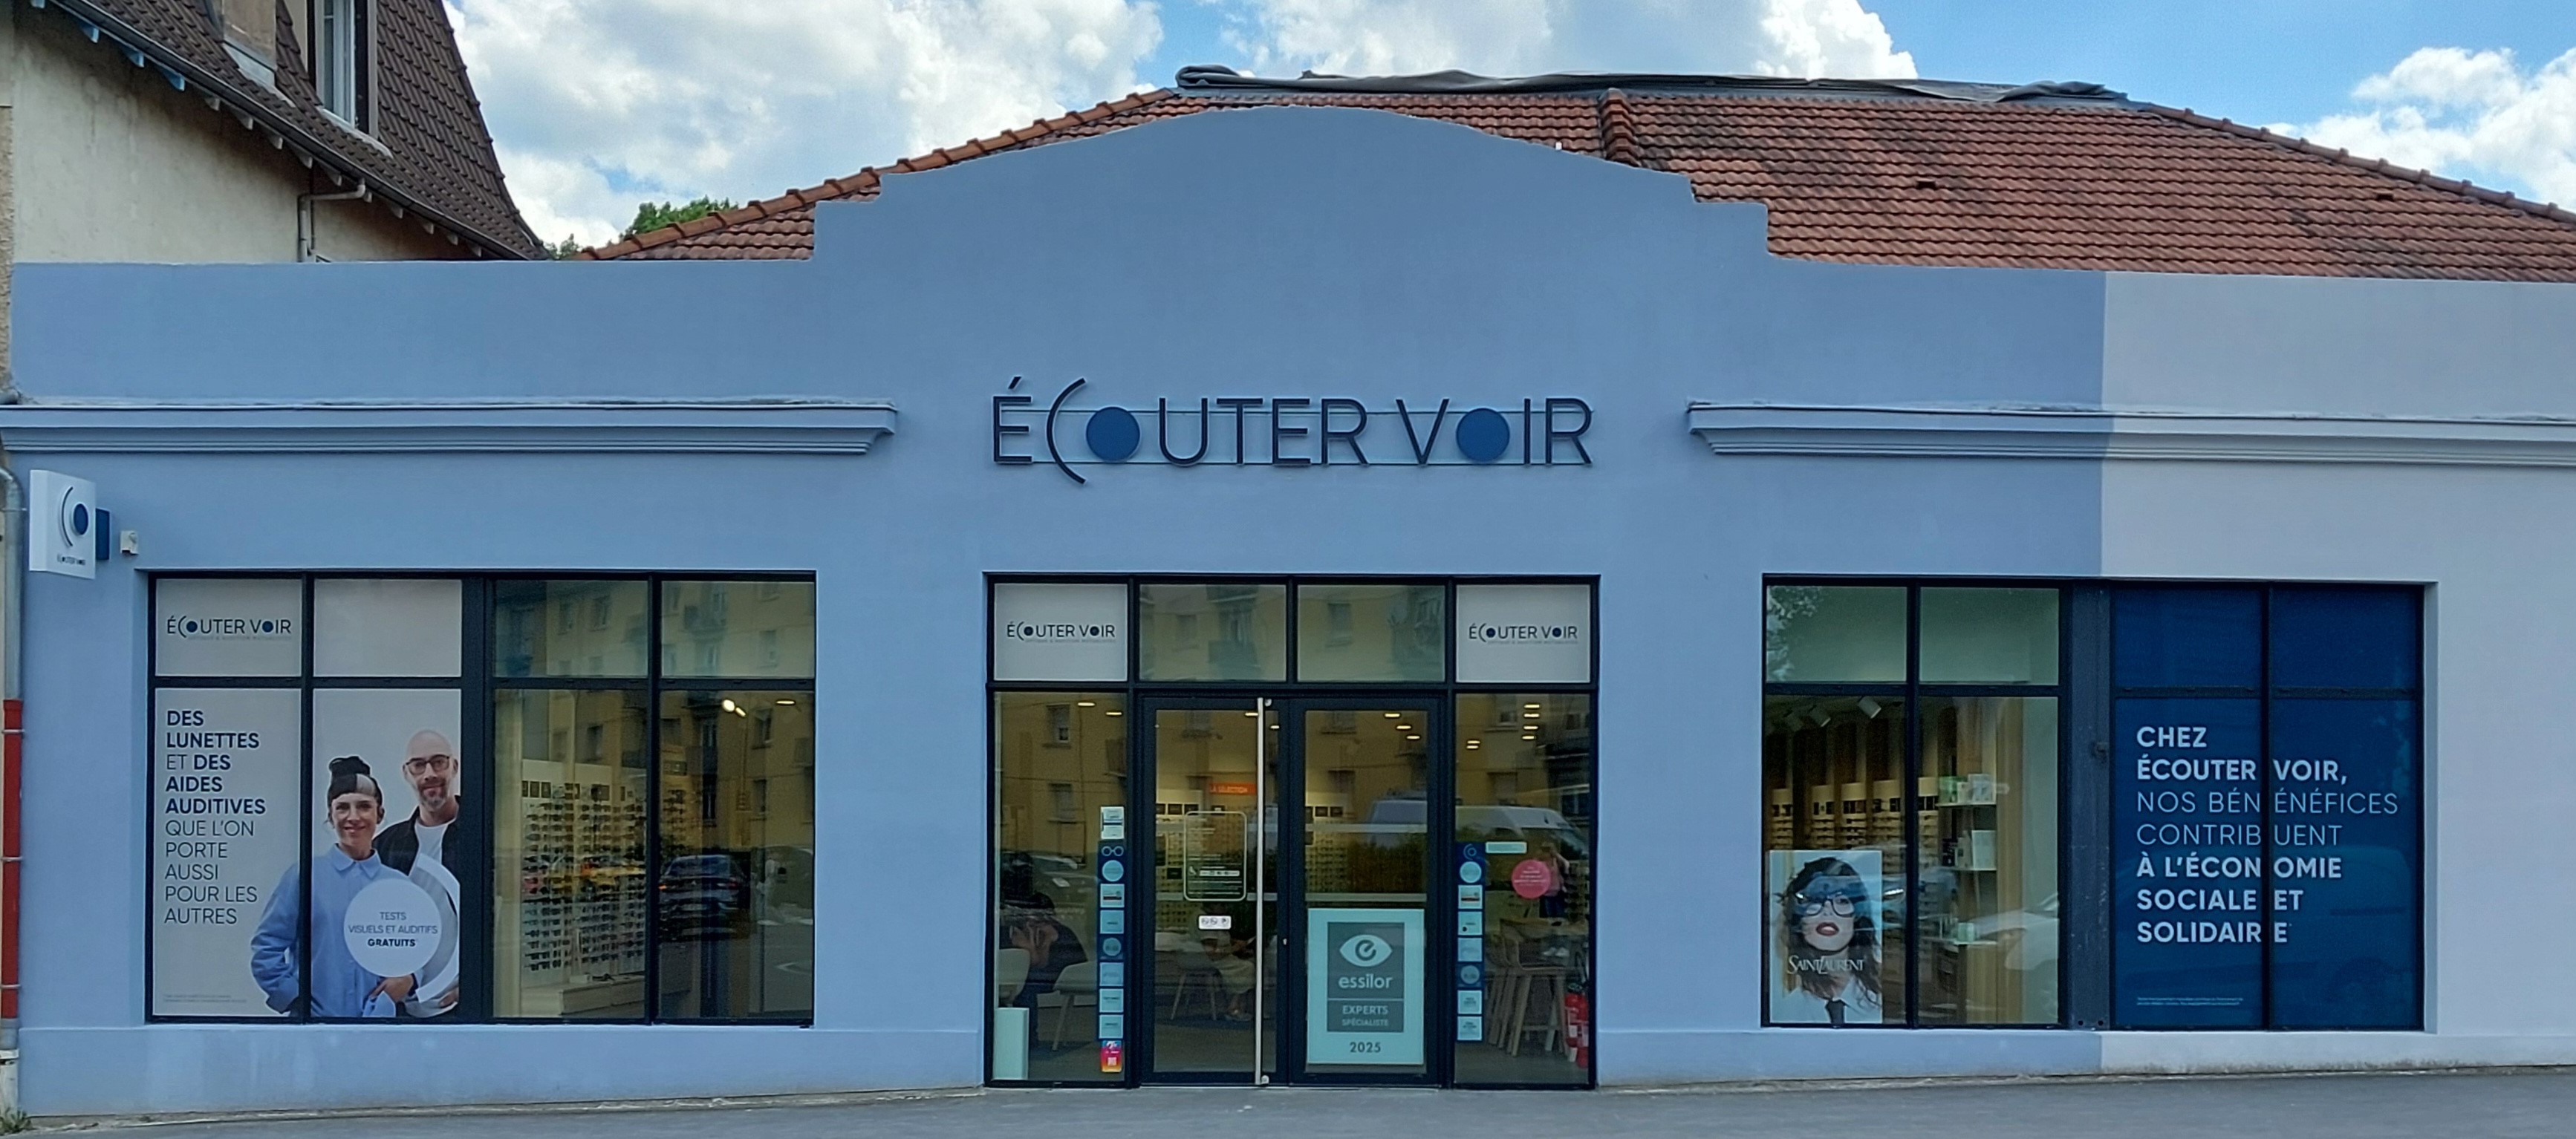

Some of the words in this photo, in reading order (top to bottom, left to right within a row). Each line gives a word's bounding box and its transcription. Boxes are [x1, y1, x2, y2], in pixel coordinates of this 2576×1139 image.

[1396, 397, 1593, 466] VOIR
[250, 619, 291, 634] VOIR
[1079, 624, 1115, 637] VOIR
[1541, 626, 1578, 639] VOIR
[167, 711, 204, 726] DES
[167, 732, 260, 748] LUNETTES
[2136, 726, 2207, 748] CHEZ
[167, 754, 188, 770] ET
[194, 754, 231, 770] DES
[2137, 754, 2257, 780] ÉCOUTER
[2272, 759, 2347, 786] VOIR,
[166, 776, 223, 792] AIDES
[165, 798, 266, 815] AUDITIVES
[2138, 792, 2196, 813] NOS
[166, 820, 206, 836] QUE
[212, 820, 254, 837] L'ON
[166, 842, 228, 858] PORTE
[165, 864, 218, 880] AUSSI
[2136, 851, 2155, 878] À
[166, 886, 219, 902] POUR
[225, 886, 258, 902] LES
[2136, 889, 2257, 910] SOCIALE
[2274, 890, 2303, 910] ET
[164, 908, 237, 924] AUTRES
[380, 912, 406, 921] TESTS
[348, 925, 384, 934] VISUELS
[386, 925, 396, 934] ET
[398, 925, 438, 934] AUDITIFS
[368, 939, 416, 947] GRATUITS
[1338, 973, 1393, 989] essilor
[1342, 1005, 1388, 1015] EXPERTS
[1350, 1042, 1381, 1053] 2025
